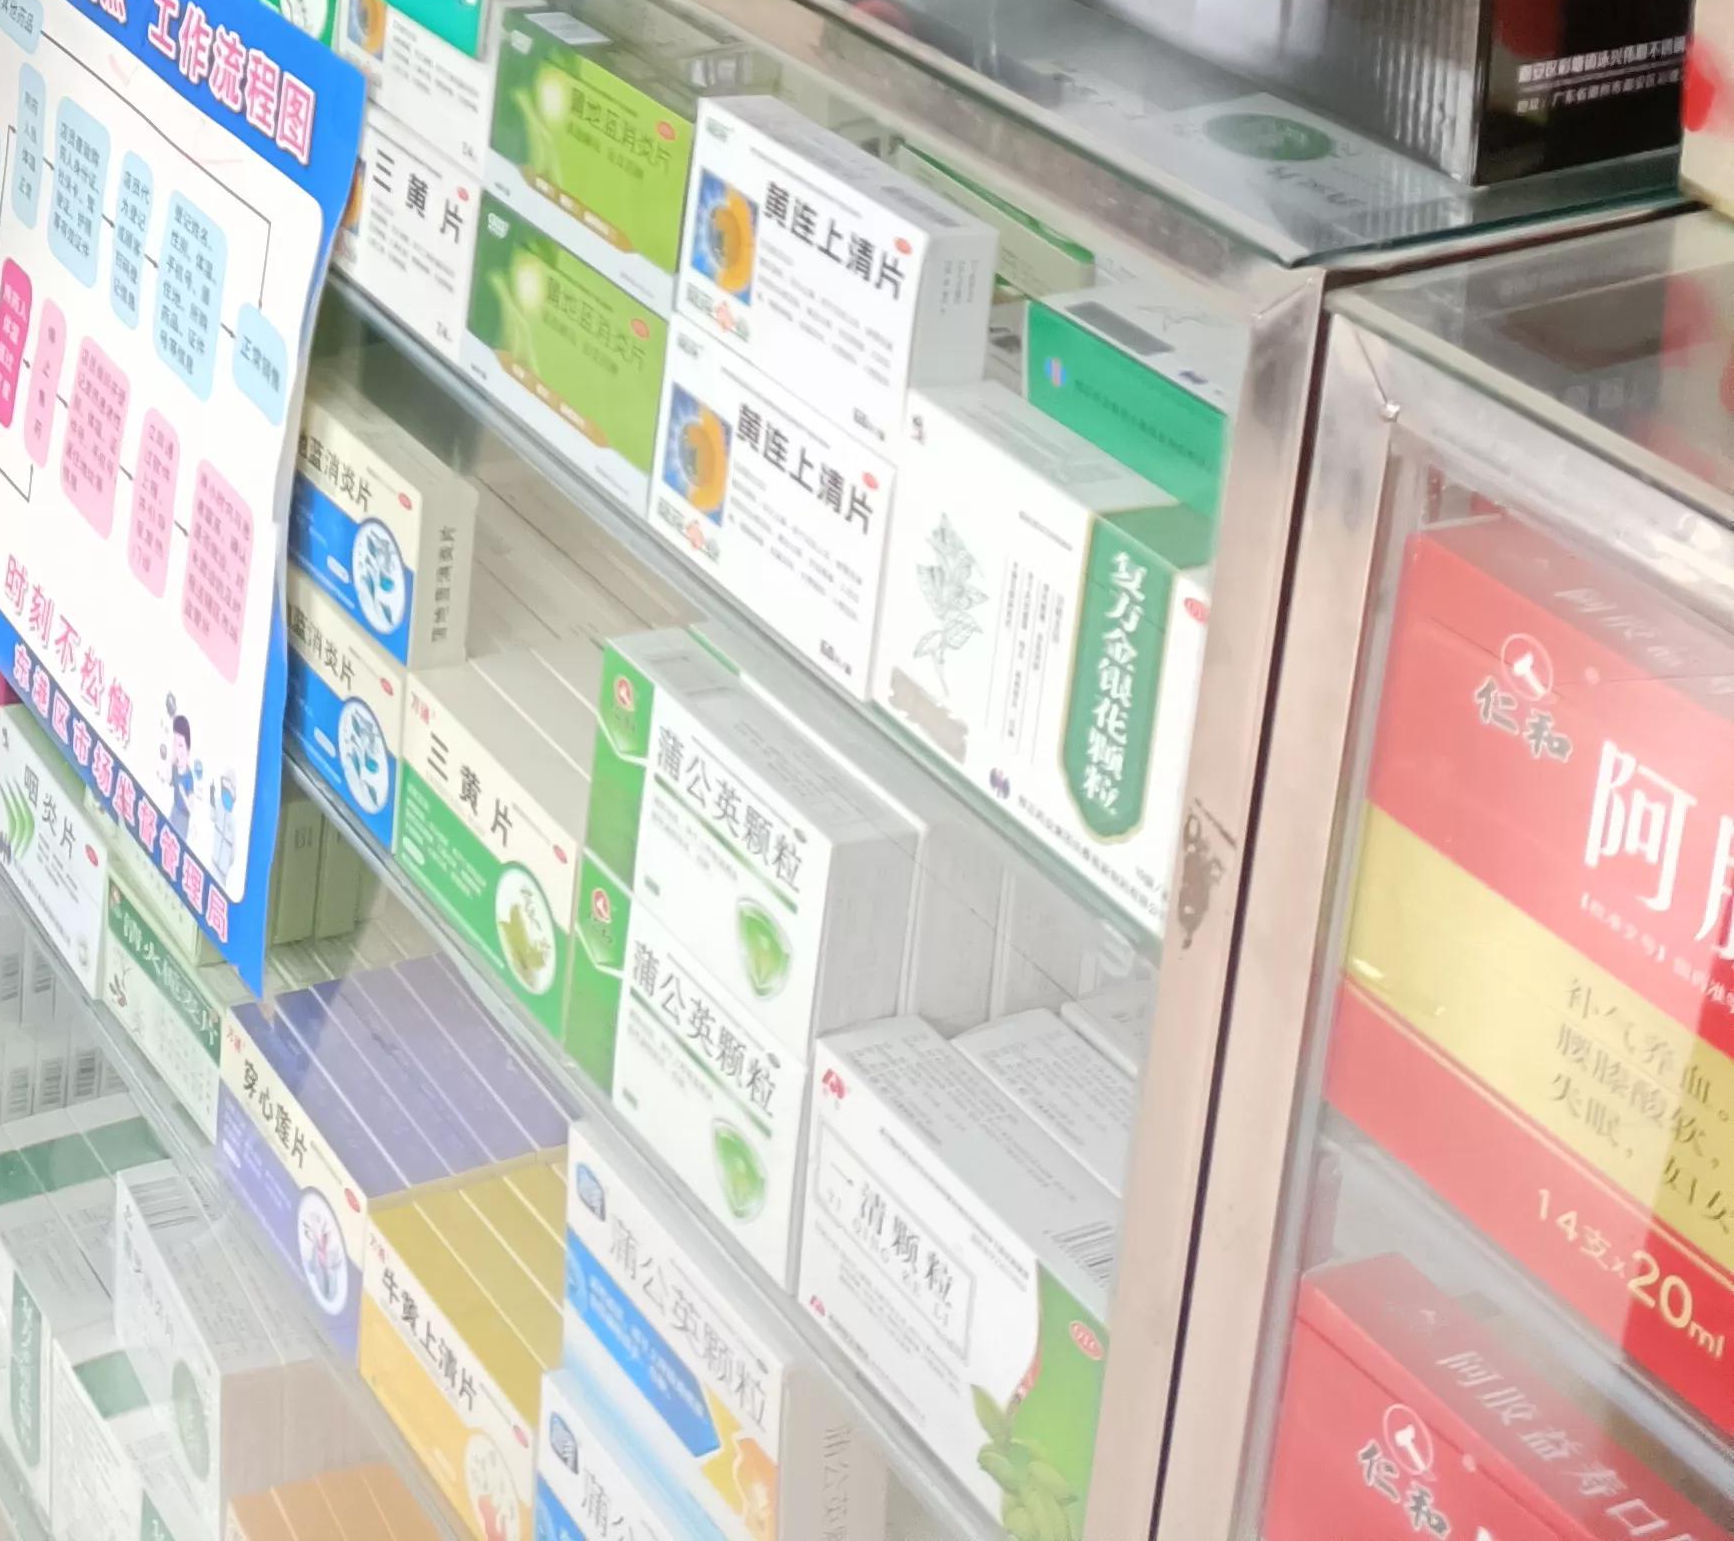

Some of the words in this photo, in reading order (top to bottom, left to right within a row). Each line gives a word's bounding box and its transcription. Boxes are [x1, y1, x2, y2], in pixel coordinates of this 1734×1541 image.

[370, 148, 469, 245] 三黄片
[760, 179, 907, 301] 黄连上清片
[734, 400, 876, 537] 黄连上清片
[3, 551, 135, 745] 时刻不松懈
[1081, 550, 1148, 817] 复方金银花颗粒
[1475, 676, 1573, 764] 仁和
[12, 641, 230, 946] 东港区市场监督管理局
[23, 762, 79, 860] 咽炎片
[425, 733, 513, 848] 三黄片
[656, 723, 805, 896] 蒲公英颗粒
[629, 939, 778, 1120] 蒲公英颗粒
[241, 1056, 309, 1170] 穿心莲片
[829, 1161, 954, 1310] 一清颗粒
[381, 1265, 480, 1412] 牛黄上清片
[609, 1216, 768, 1435] 蒲公英颗粒
[1358, 1441, 1453, 1540] 仁和
[1436, 1348, 1706, 1541] 阿胶益寿口
